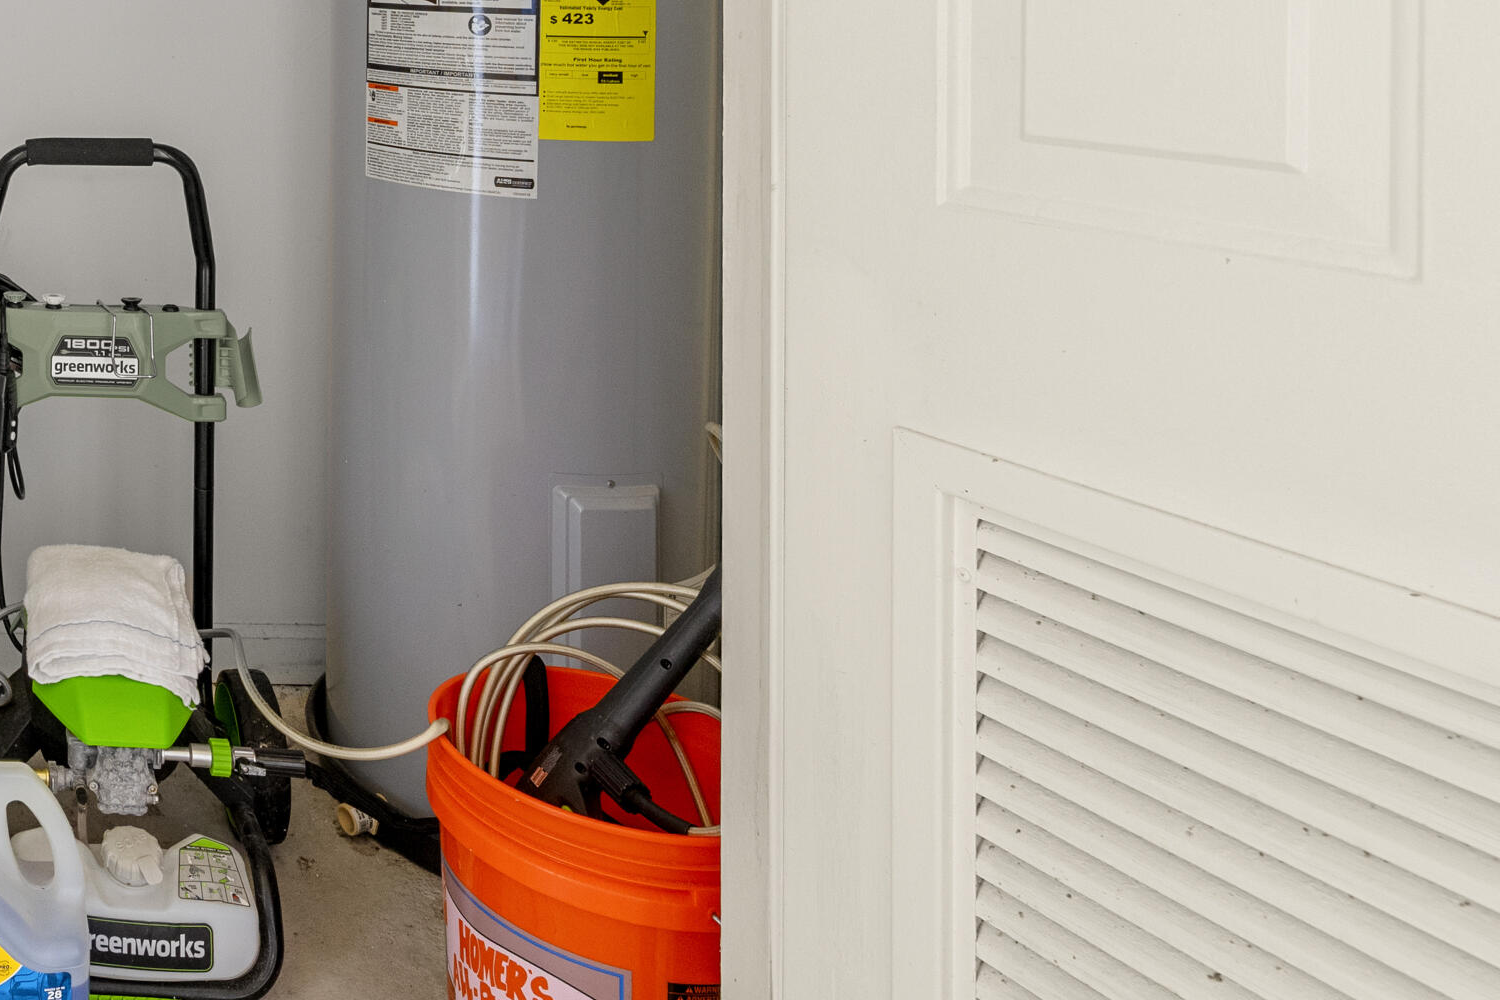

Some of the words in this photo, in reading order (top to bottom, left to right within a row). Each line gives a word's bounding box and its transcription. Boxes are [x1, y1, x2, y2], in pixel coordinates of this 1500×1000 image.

[562, 13, 594, 25] 423
[64, 339, 113, 349] 1800
[89, 934, 205, 958] reenworks
[458, 918, 554, 1000] HOMER'S
[47, 990, 62, 1000] 28
